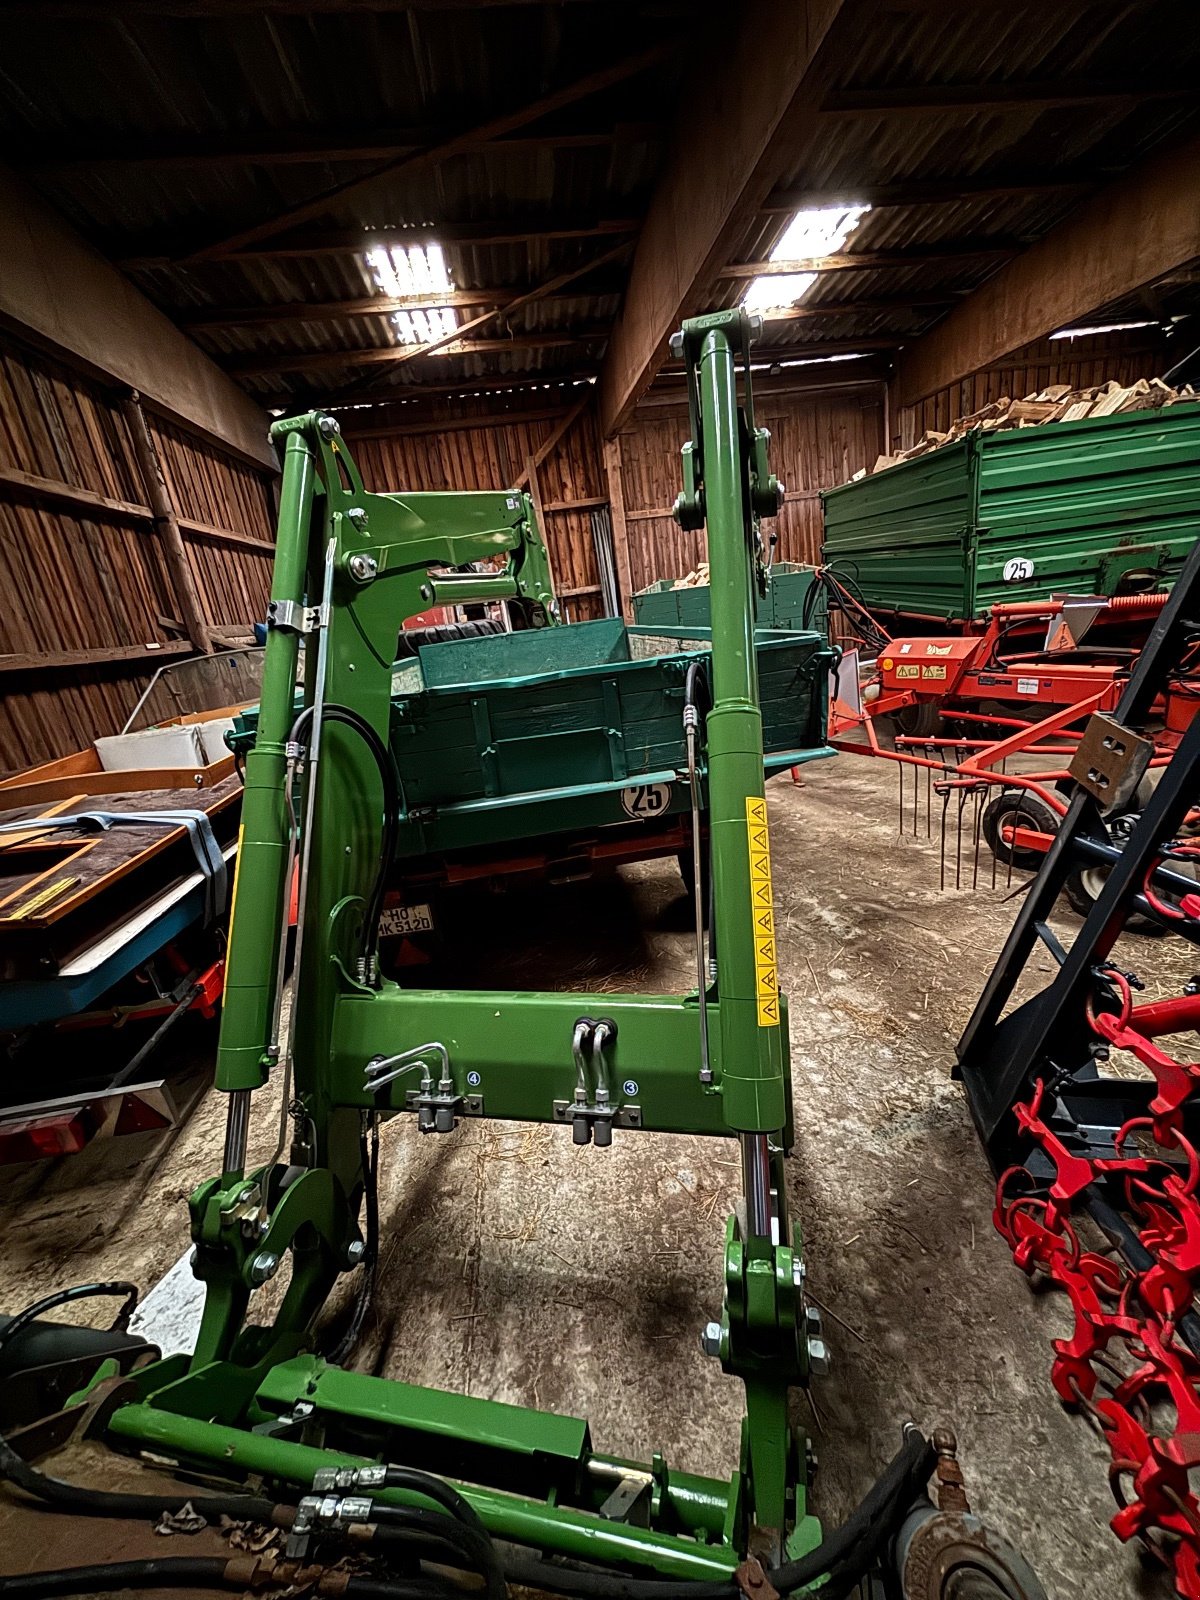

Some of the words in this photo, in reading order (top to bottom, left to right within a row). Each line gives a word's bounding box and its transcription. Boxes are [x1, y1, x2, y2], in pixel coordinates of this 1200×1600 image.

[1010, 561, 1027, 580] 25
[630, 785, 662, 812] 25
[390, 908, 409, 922] HO
[395, 917, 430, 933] 5120
[469, 1072, 478, 1084] 4
[626, 1082, 636, 1094] 3
